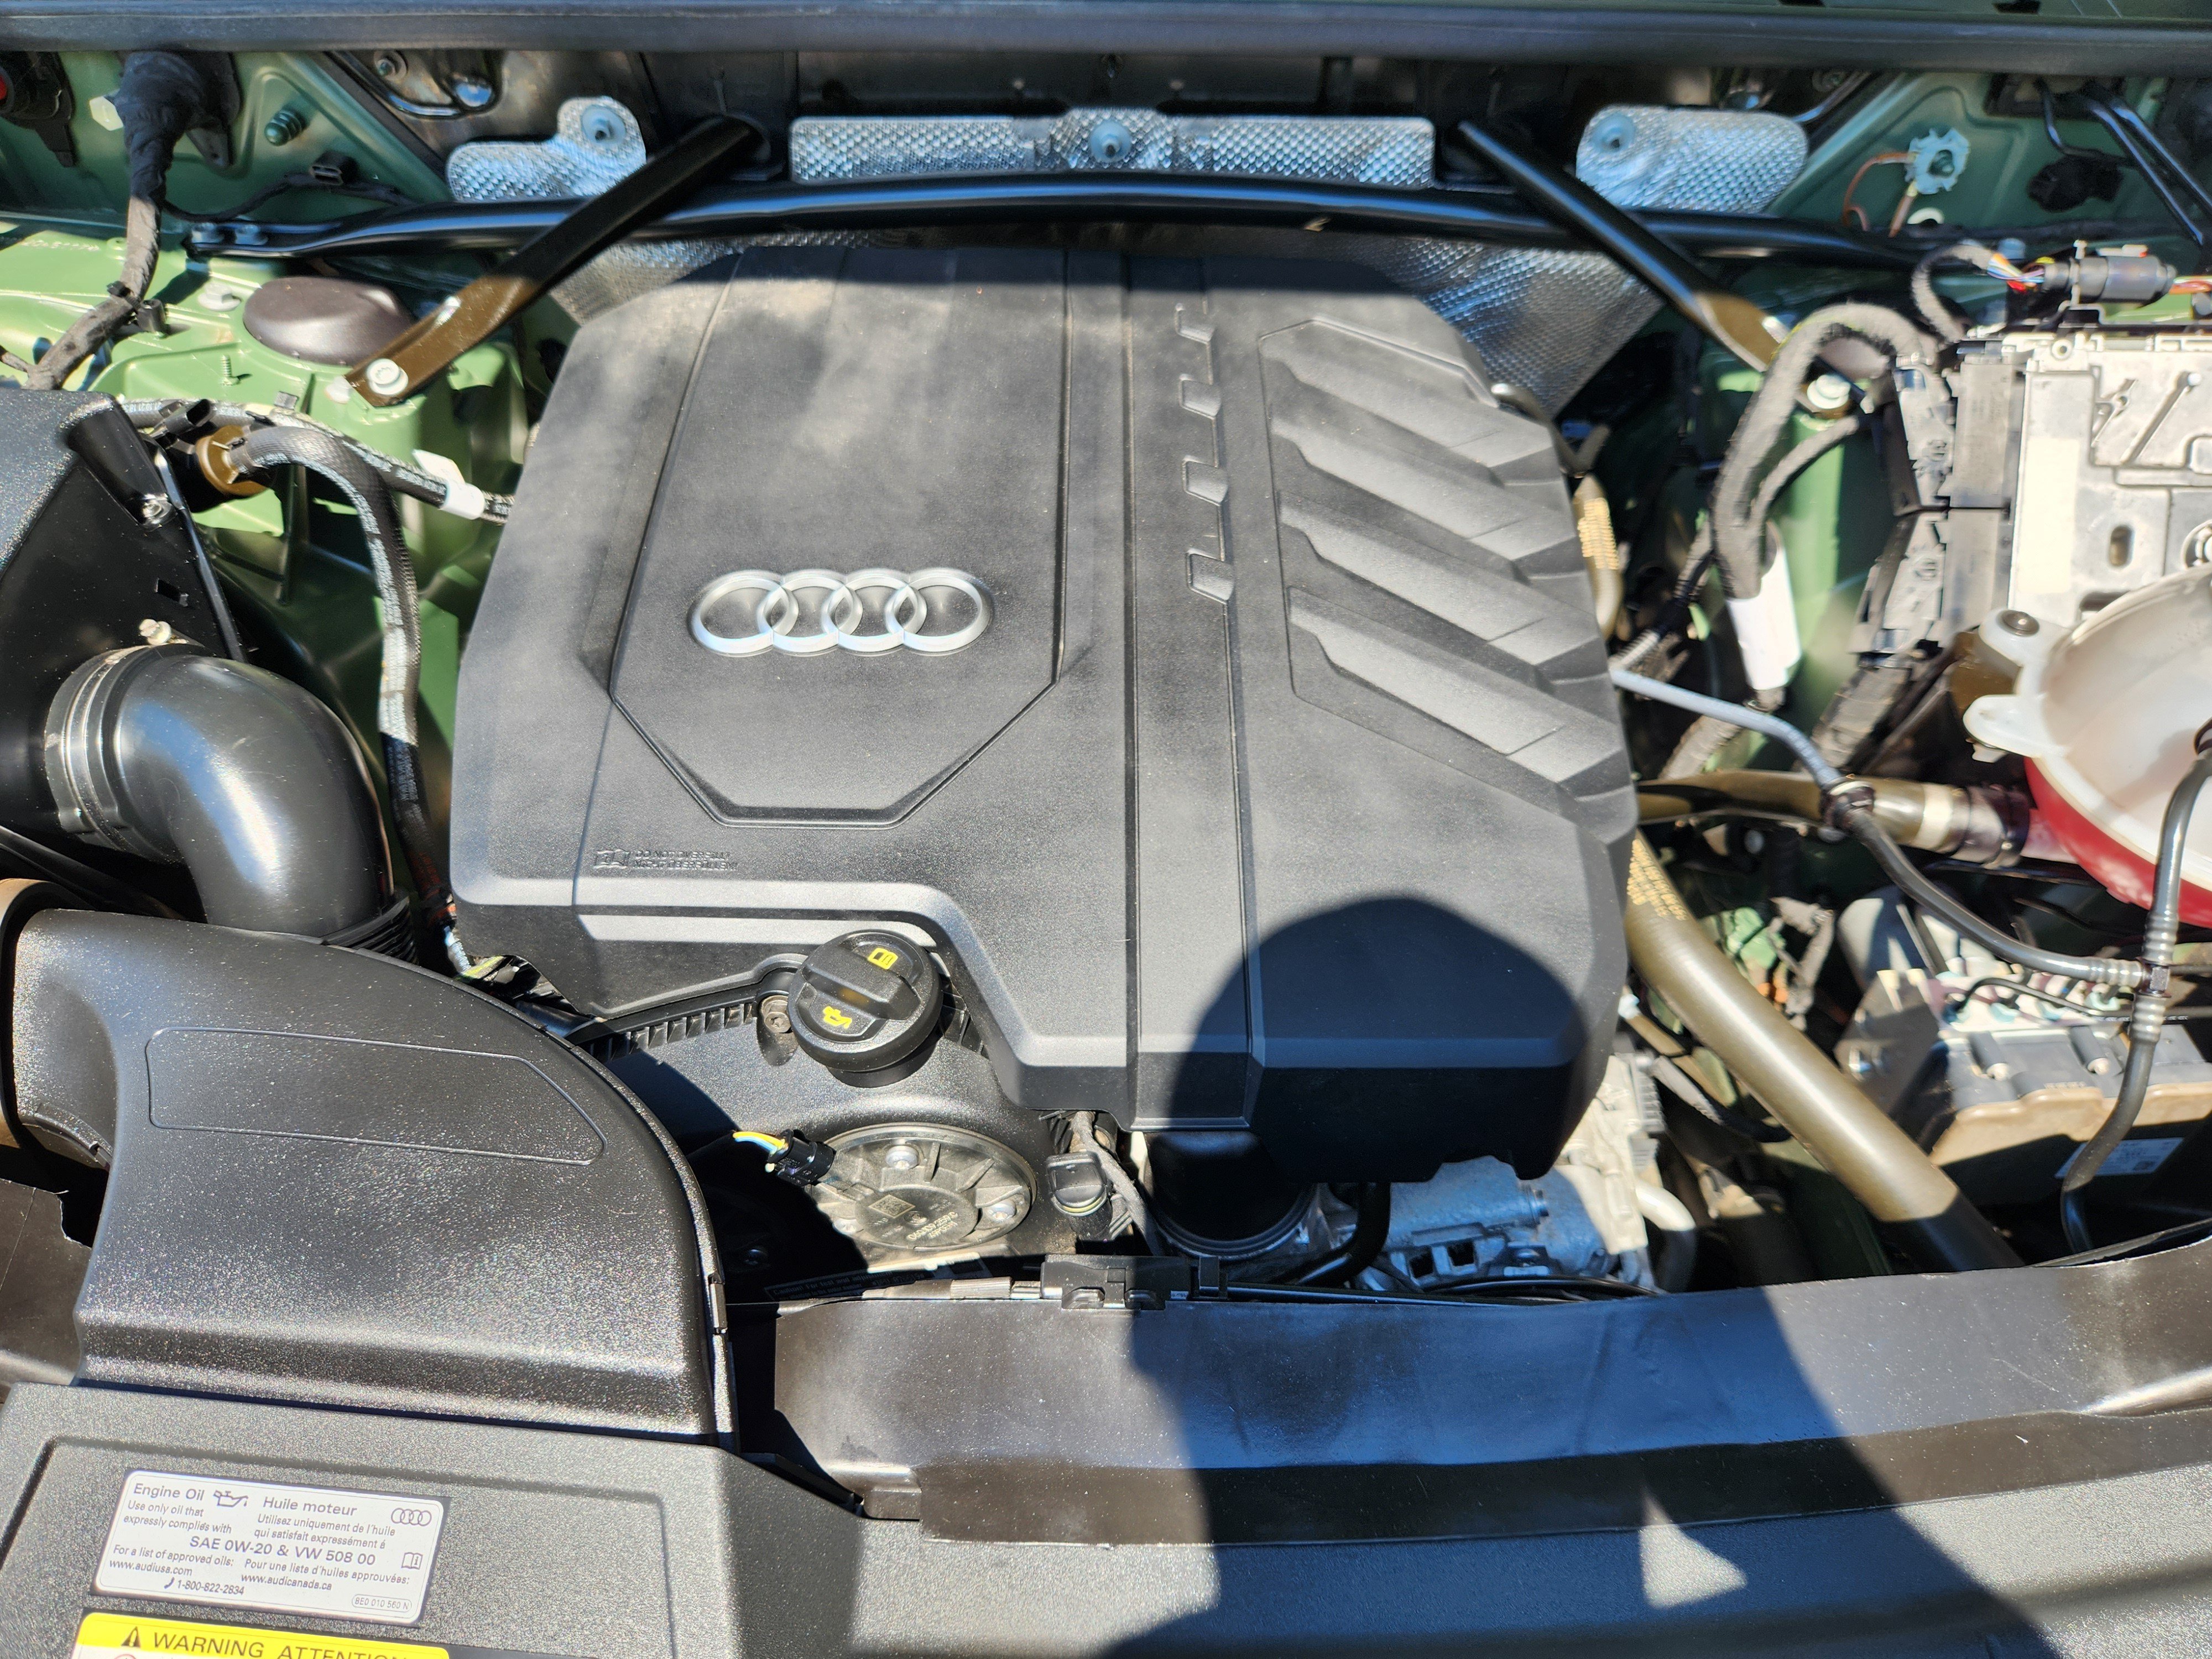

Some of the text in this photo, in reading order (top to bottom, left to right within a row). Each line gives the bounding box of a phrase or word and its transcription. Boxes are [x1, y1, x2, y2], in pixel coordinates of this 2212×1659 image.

[133, 1483, 205, 1501] Engine Oil
[127, 1500, 205, 1517] Use only oil that
[263, 1496, 358, 1516] Huile moteur
[123, 1515, 232, 1535] expressly complies with
[257, 1514, 291, 1526] Utilisez
[294, 1517, 351, 1532] uniquement
[353, 1523, 364, 1533] de
[254, 1528, 270, 1539] qui
[271, 1530, 309, 1542] satisfait
[310, 1534, 378, 1549] expressément
[113, 1544, 234, 1567] For a list of approved oils:
[189, 1535, 377, 1566] SAE 0W-20 & VW 508 00
[109, 1560, 193, 1576] www.audiusa.com
[244, 1558, 268, 1569] Pour
[269, 1562, 287, 1572] une
[289, 1563, 310, 1574] liste
[351, 1571, 410, 1585] approuvées:
[177, 1579, 245, 1595] 1-800-822-2834
[241, 1574, 332, 1591] www.audicanada.ca
[354, 1597, 410, 1610] 8E0 010 560 N
[153, 1632, 264, 1658] WARNING
